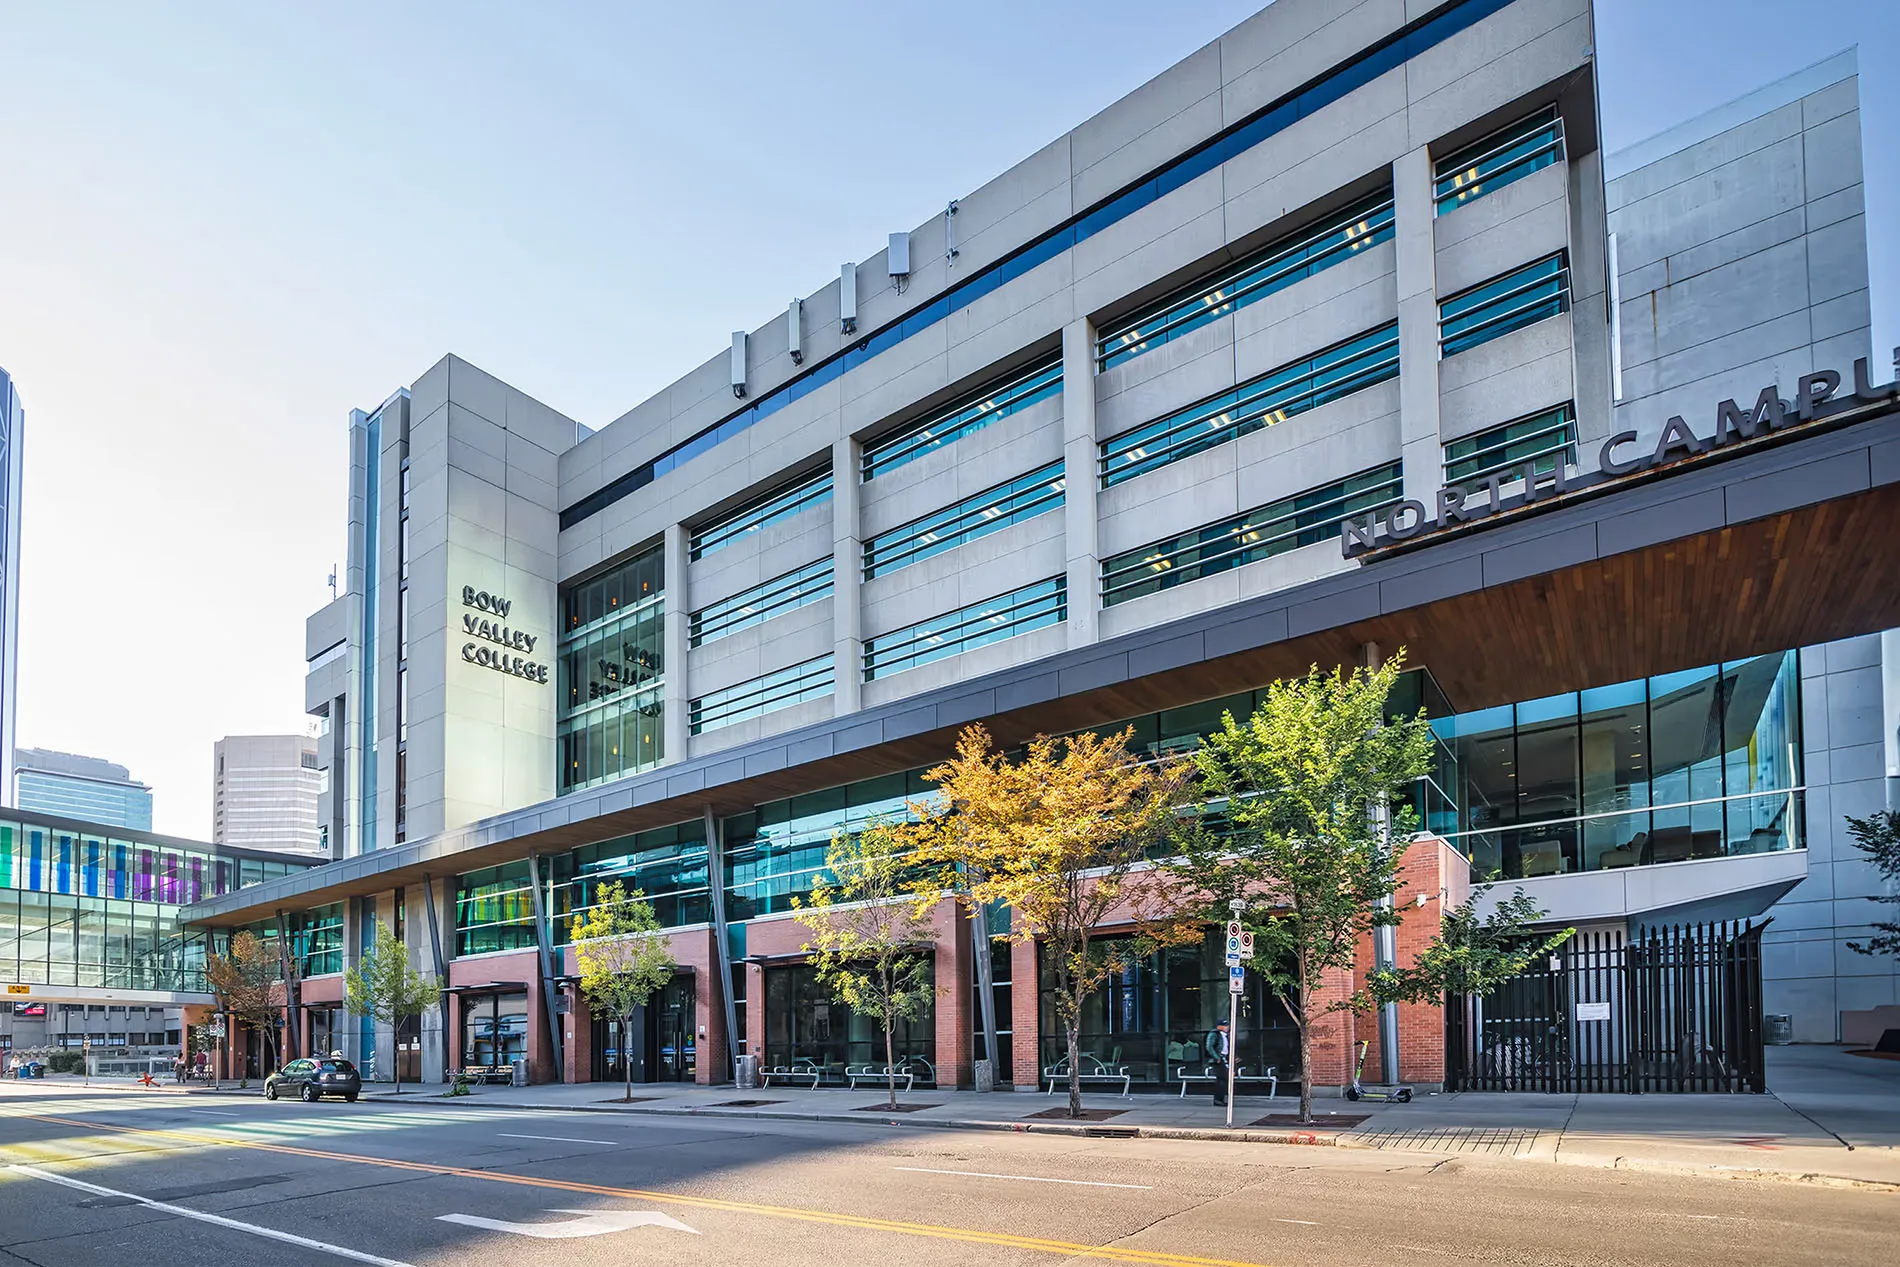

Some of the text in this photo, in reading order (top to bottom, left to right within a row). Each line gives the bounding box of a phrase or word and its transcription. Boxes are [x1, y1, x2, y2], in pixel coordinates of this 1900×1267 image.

[1341, 450, 1565, 558] NORTH
[463, 585, 511, 617] BOW
[463, 613, 538, 652] VALLEY
[462, 642, 549, 684] COLLEGE
